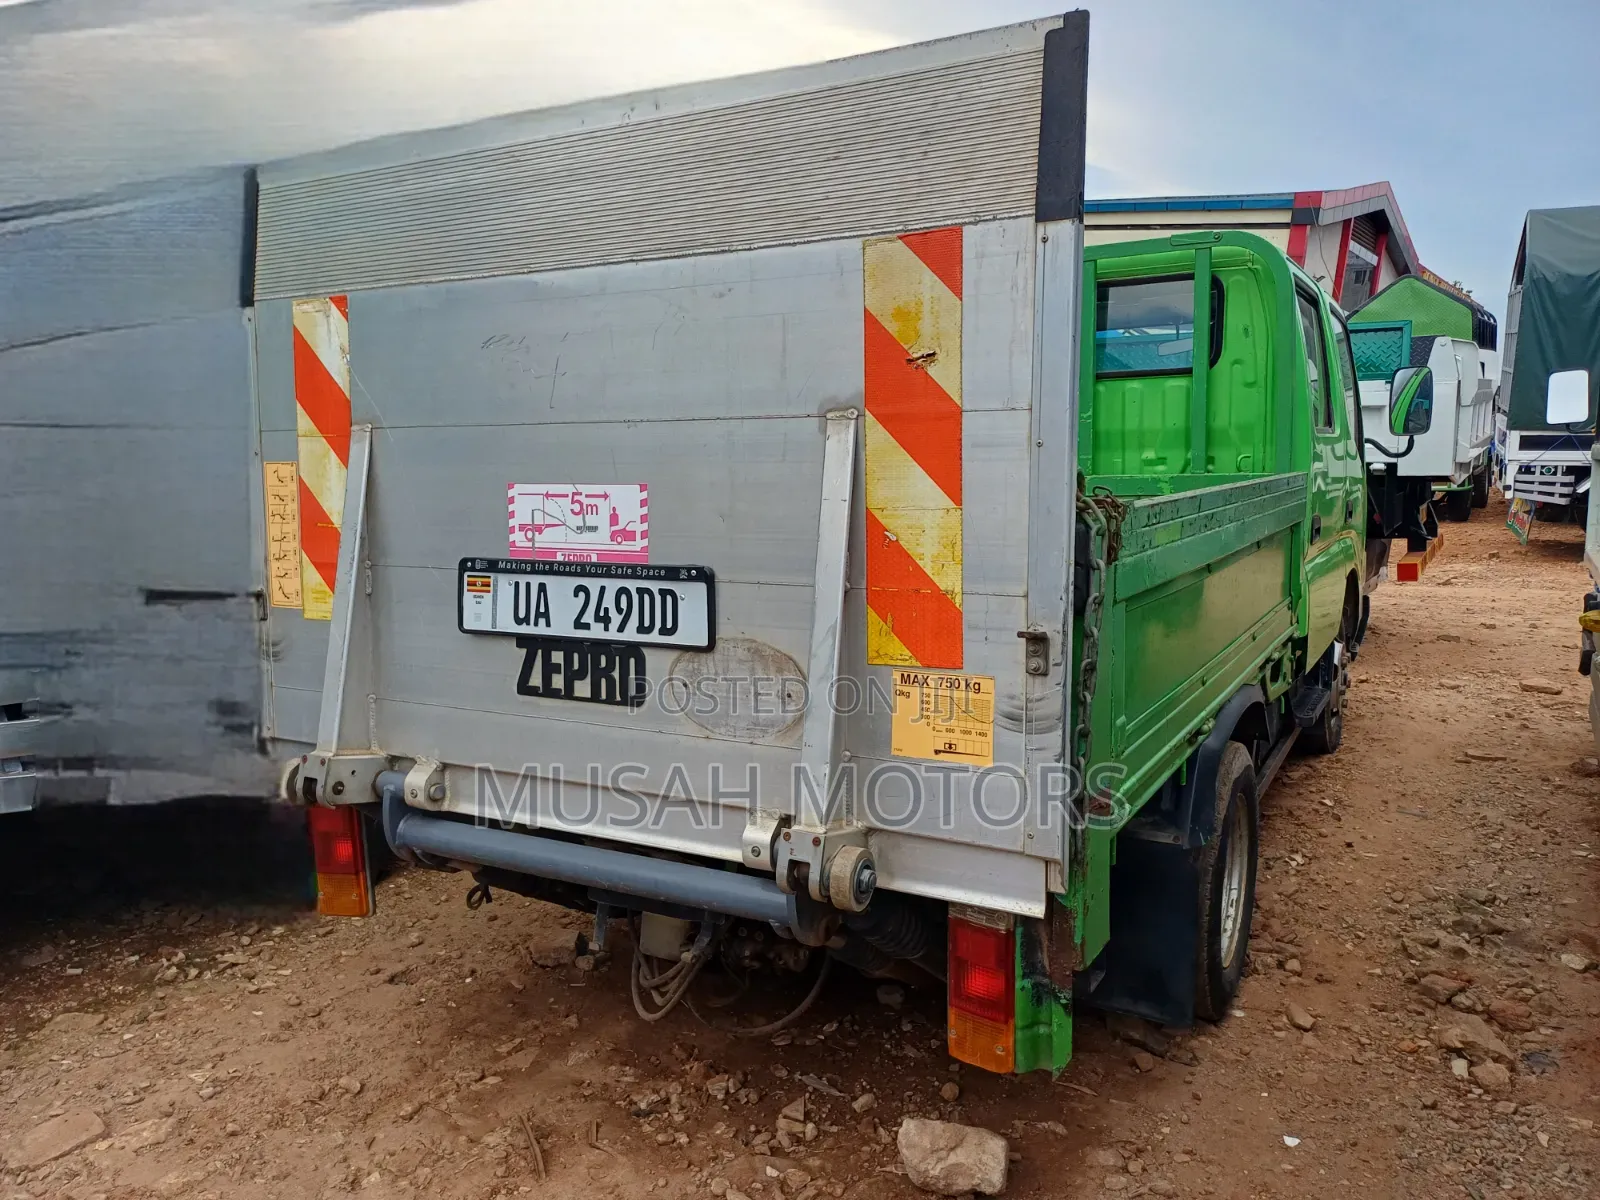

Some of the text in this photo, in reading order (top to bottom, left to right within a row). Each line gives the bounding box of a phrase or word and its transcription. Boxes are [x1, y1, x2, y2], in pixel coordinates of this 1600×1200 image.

[569, 492, 599, 516] 5m
[498, 560, 532, 572] Making
[535, 562, 550, 572] the
[553, 563, 581, 574] Roads
[585, 565, 607, 575] Your
[610, 566, 632, 576] Safe
[636, 567, 666, 579] Space
[513, 580, 552, 628] UA
[573, 584, 679, 636] 249DD
[900, 673, 981, 694] MAX 750 kg
